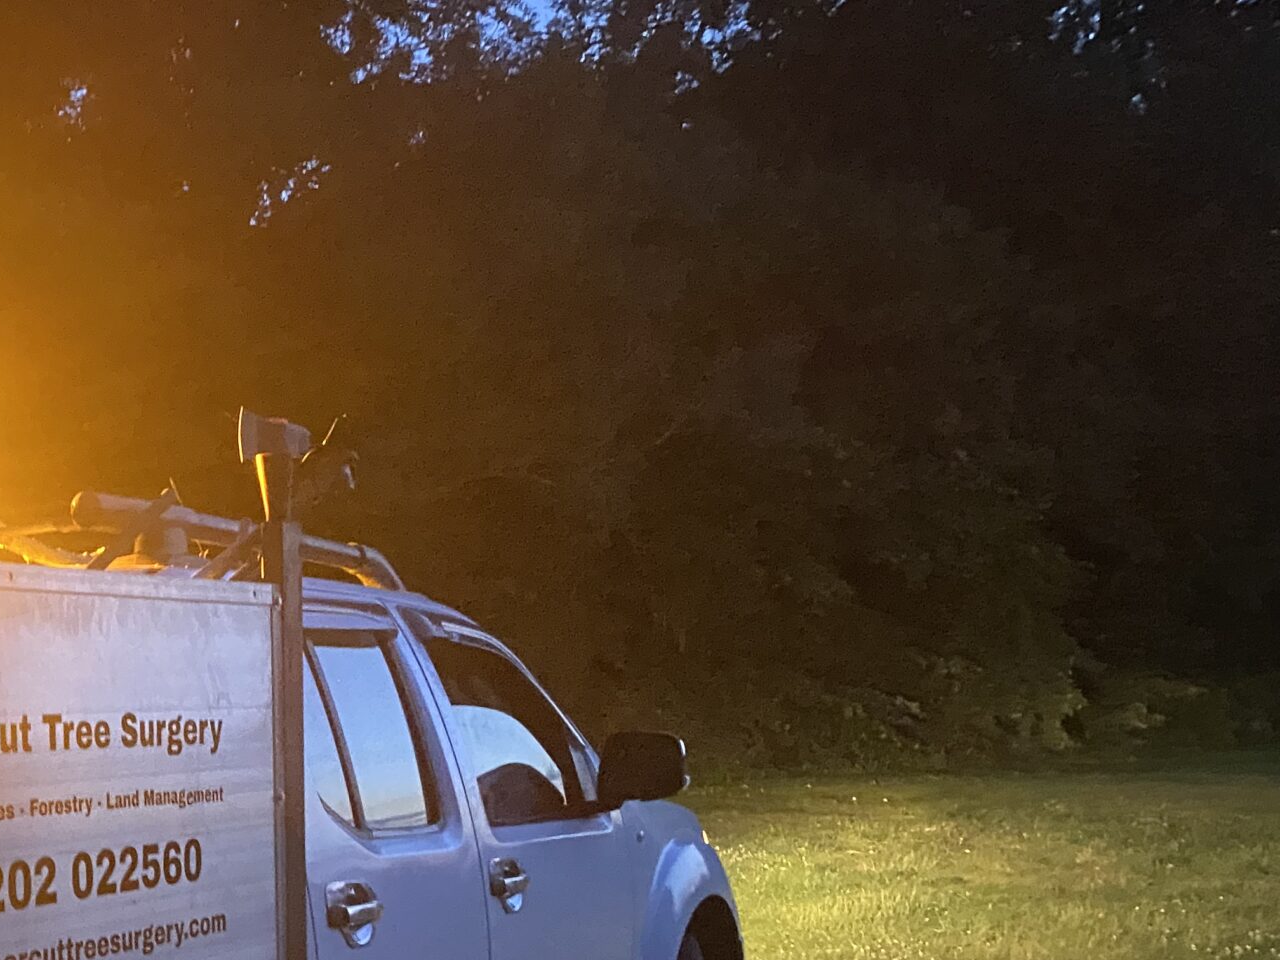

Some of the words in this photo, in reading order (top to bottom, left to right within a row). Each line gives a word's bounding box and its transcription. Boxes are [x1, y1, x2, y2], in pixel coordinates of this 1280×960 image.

[42, 713, 111, 750] Tree
[121, 711, 223, 756] Surgery
[29, 796, 93, 817] Forestry
[106, 791, 140, 811] Land
[144, 786, 224, 809] Management
[72, 837, 203, 900] 022560
